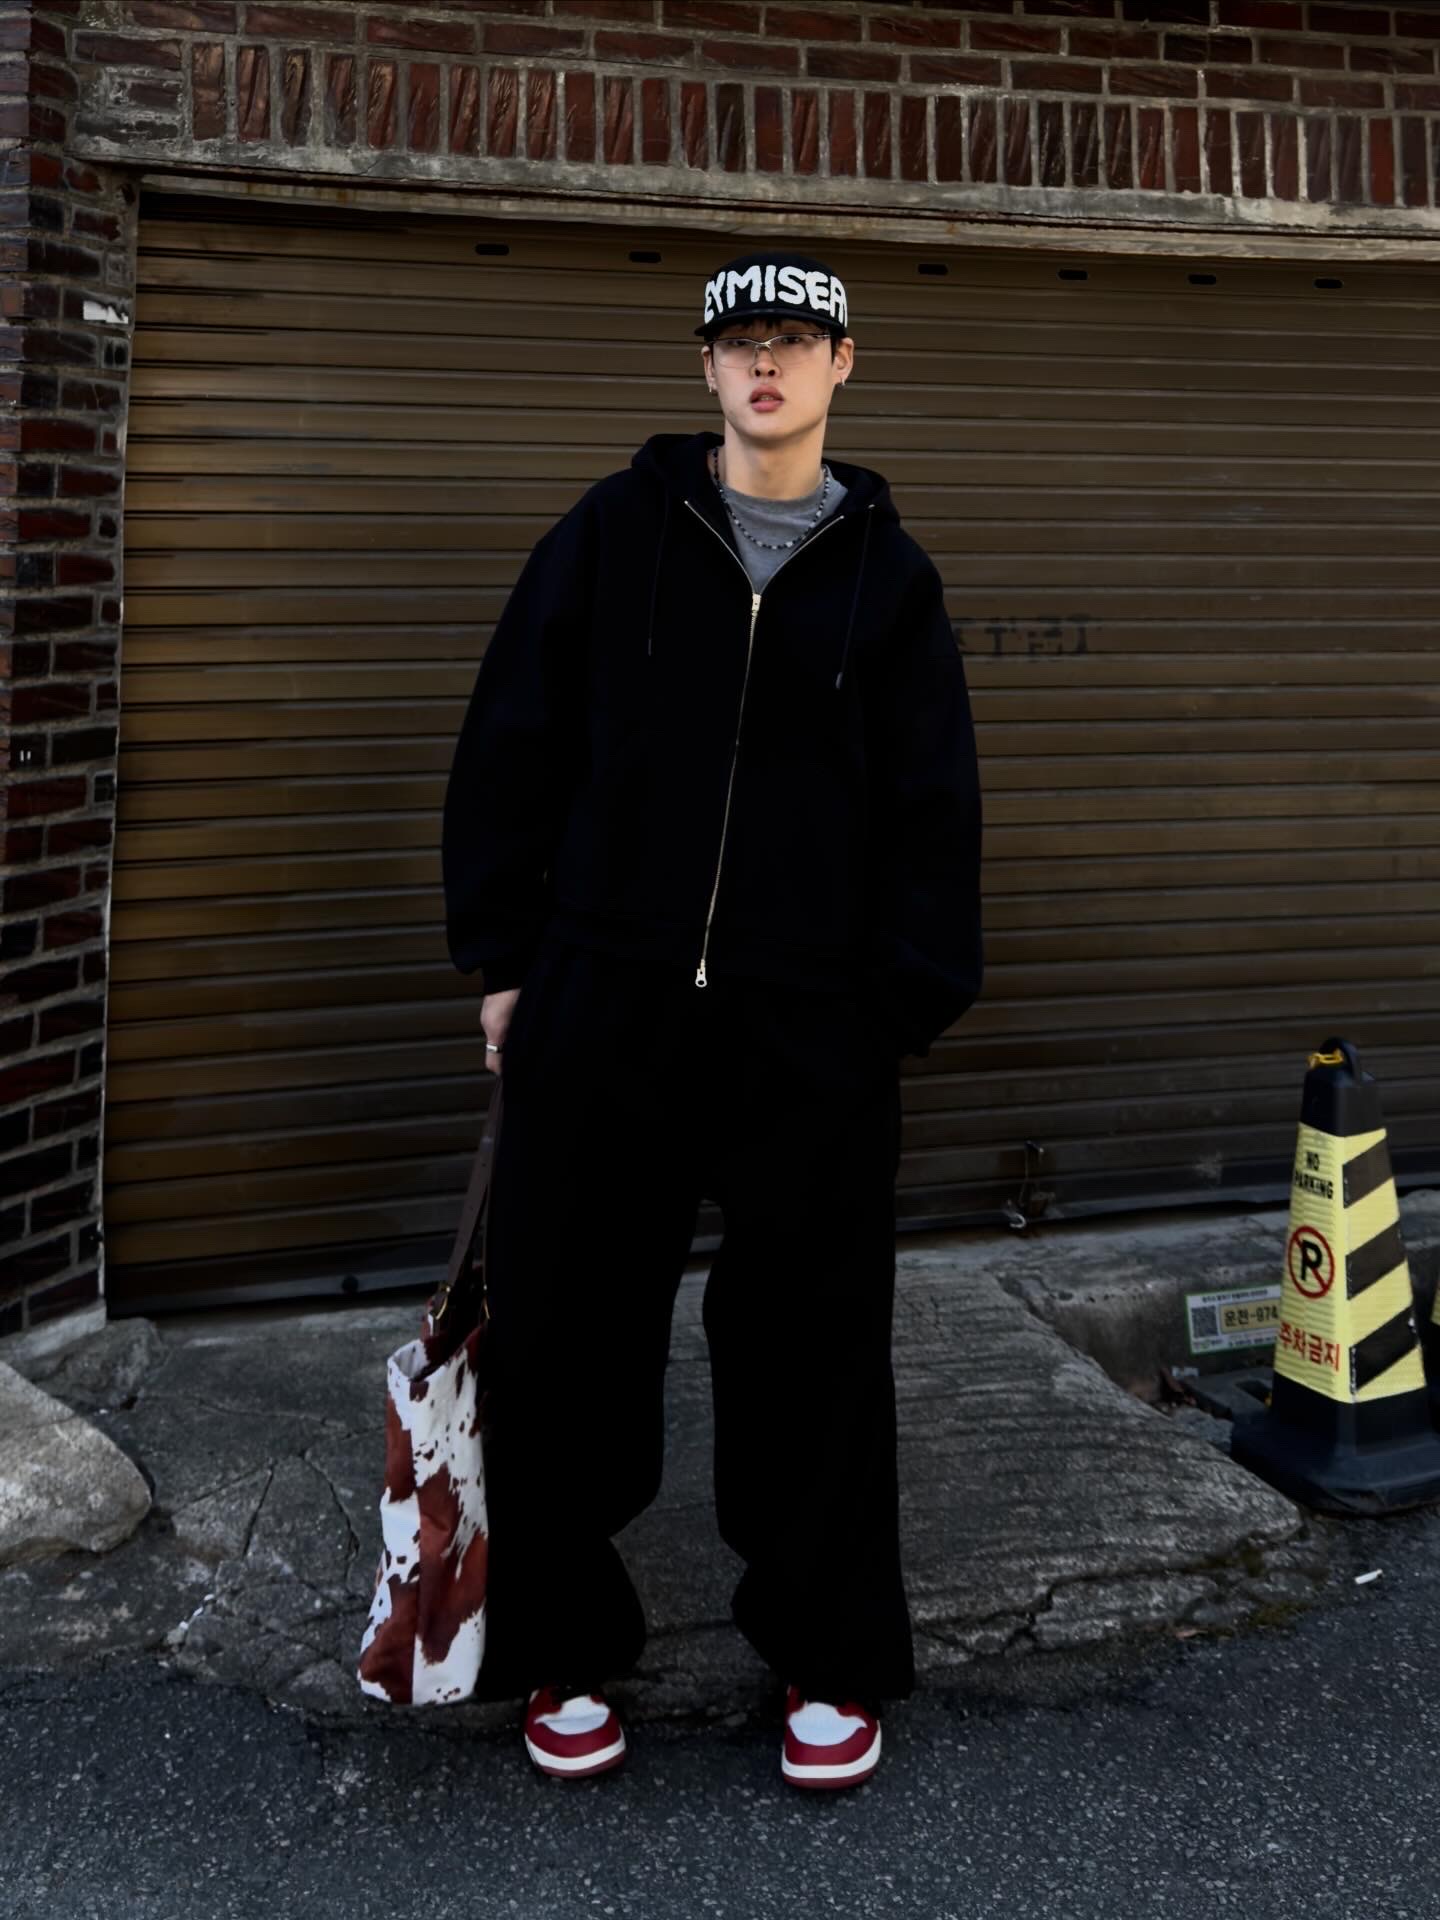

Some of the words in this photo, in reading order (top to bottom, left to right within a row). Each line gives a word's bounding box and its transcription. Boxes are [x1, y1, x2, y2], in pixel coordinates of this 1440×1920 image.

[1306, 1151, 1320, 1171] NO
[1295, 1170, 1334, 1199] PARKING
[1279, 1320, 1340, 1373] 주차금지
